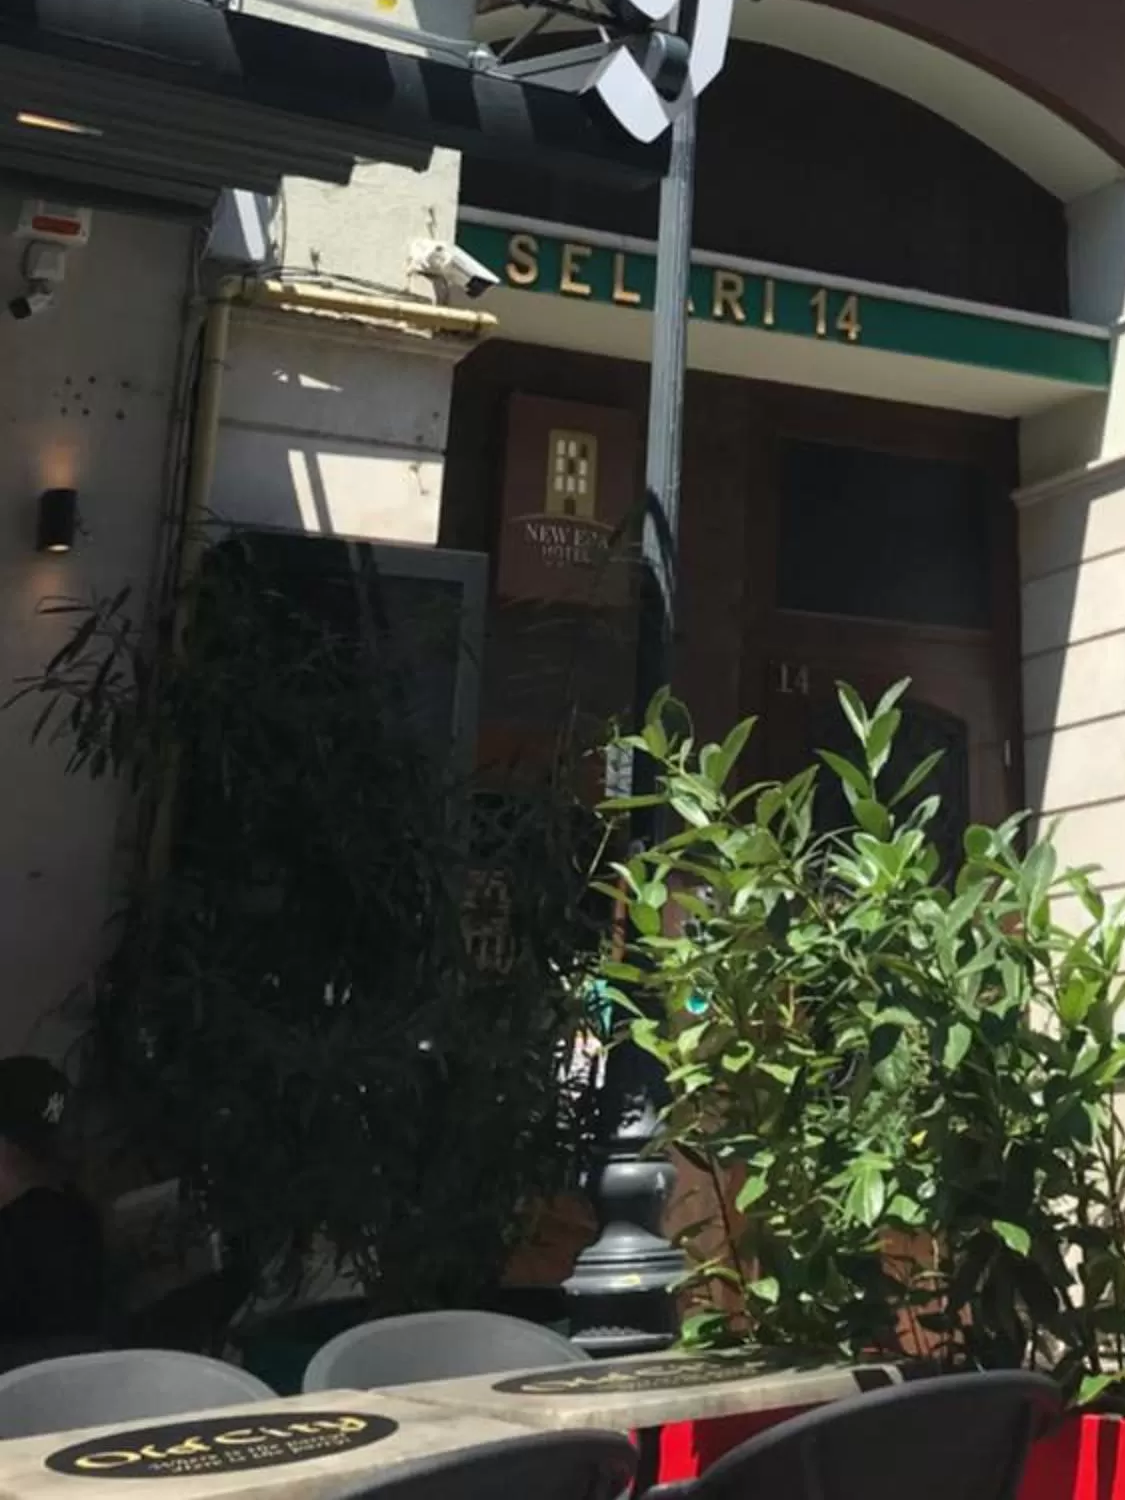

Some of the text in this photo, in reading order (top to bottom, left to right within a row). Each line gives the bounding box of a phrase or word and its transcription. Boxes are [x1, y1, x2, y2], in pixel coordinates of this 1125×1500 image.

[505, 233, 864, 342] SELRI 14
[524, 523, 571, 544] NEW
